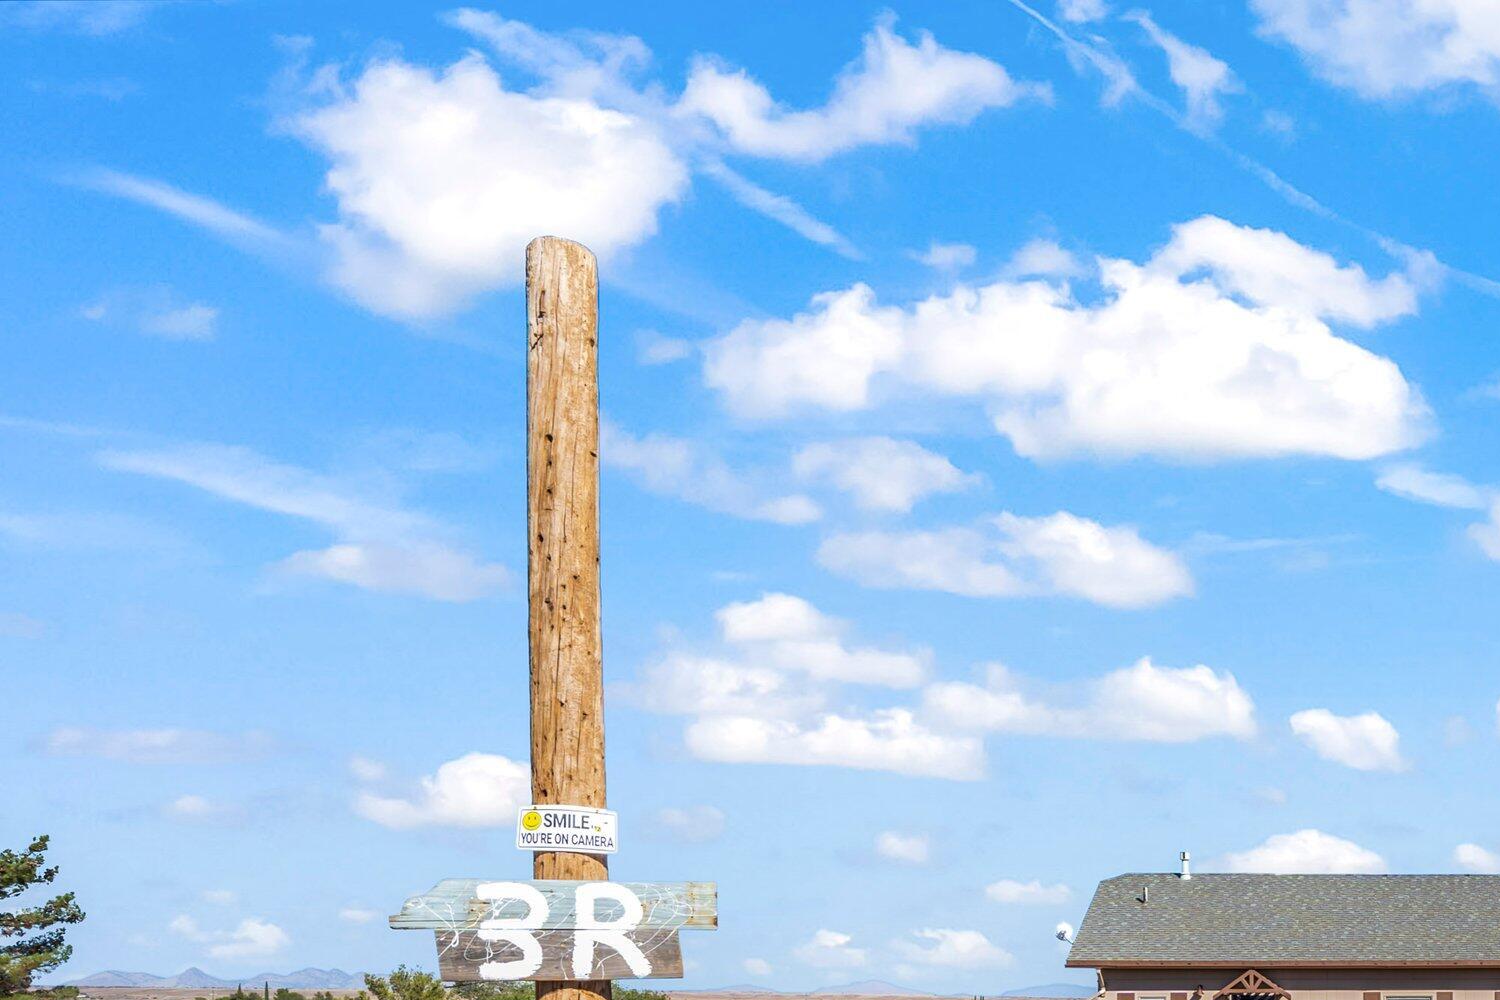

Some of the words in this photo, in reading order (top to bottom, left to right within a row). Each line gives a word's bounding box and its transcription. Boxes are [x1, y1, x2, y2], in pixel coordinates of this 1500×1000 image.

[521, 832, 552, 844] YOU'RE
[554, 833, 569, 845] ON
[571, 834, 614, 847] CAMERA
[476, 881, 550, 980] 3
[571, 881, 652, 980] R
